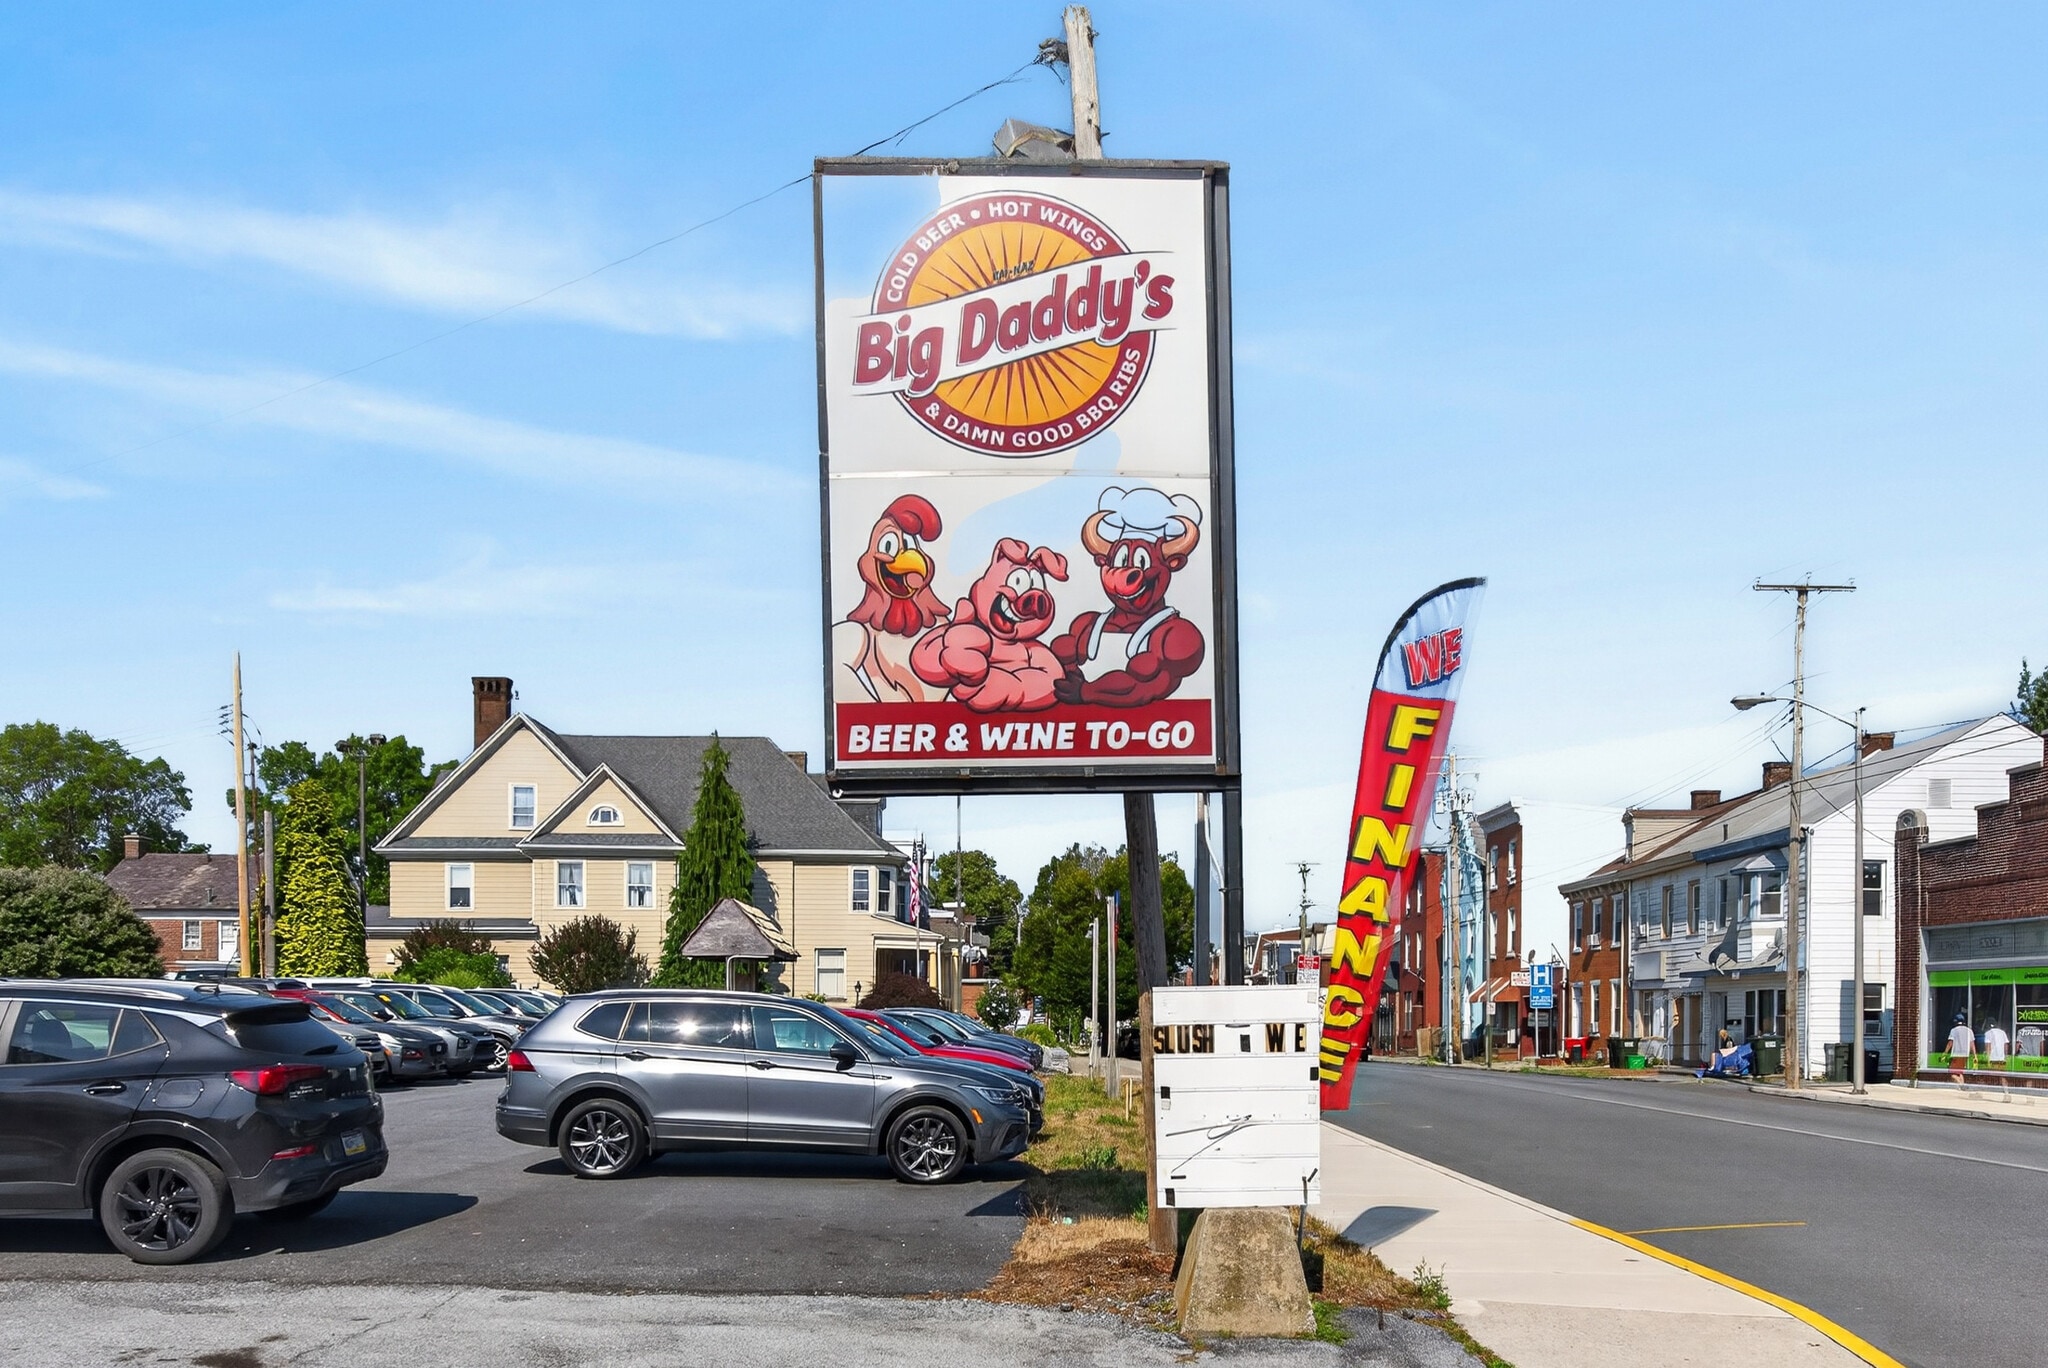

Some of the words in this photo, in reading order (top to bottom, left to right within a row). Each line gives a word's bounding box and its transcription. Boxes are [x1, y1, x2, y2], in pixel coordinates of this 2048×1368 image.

[886, 252, 918, 303] COLD
[916, 213, 966, 252] BEER
[988, 201, 1032, 218] HOT
[1040, 205, 1107, 251] WINGS
[853, 314, 944, 395] Big
[956, 259, 1175, 367] Daddy's
[925, 402, 940, 420] &
[943, 414, 1005, 446] DAMN
[1012, 422, 1073, 447] GOOD
[1076, 395, 1118, 429] BBQ
[1109, 348, 1140, 396] RIBS
[1402, 626, 1464, 688] WE
[848, 724, 937, 754] BEER
[944, 723, 969, 752] &
[980, 722, 1076, 751] WINE
[1086, 720, 1196, 750] TO-GO
[1533, 965, 1550, 986] H
